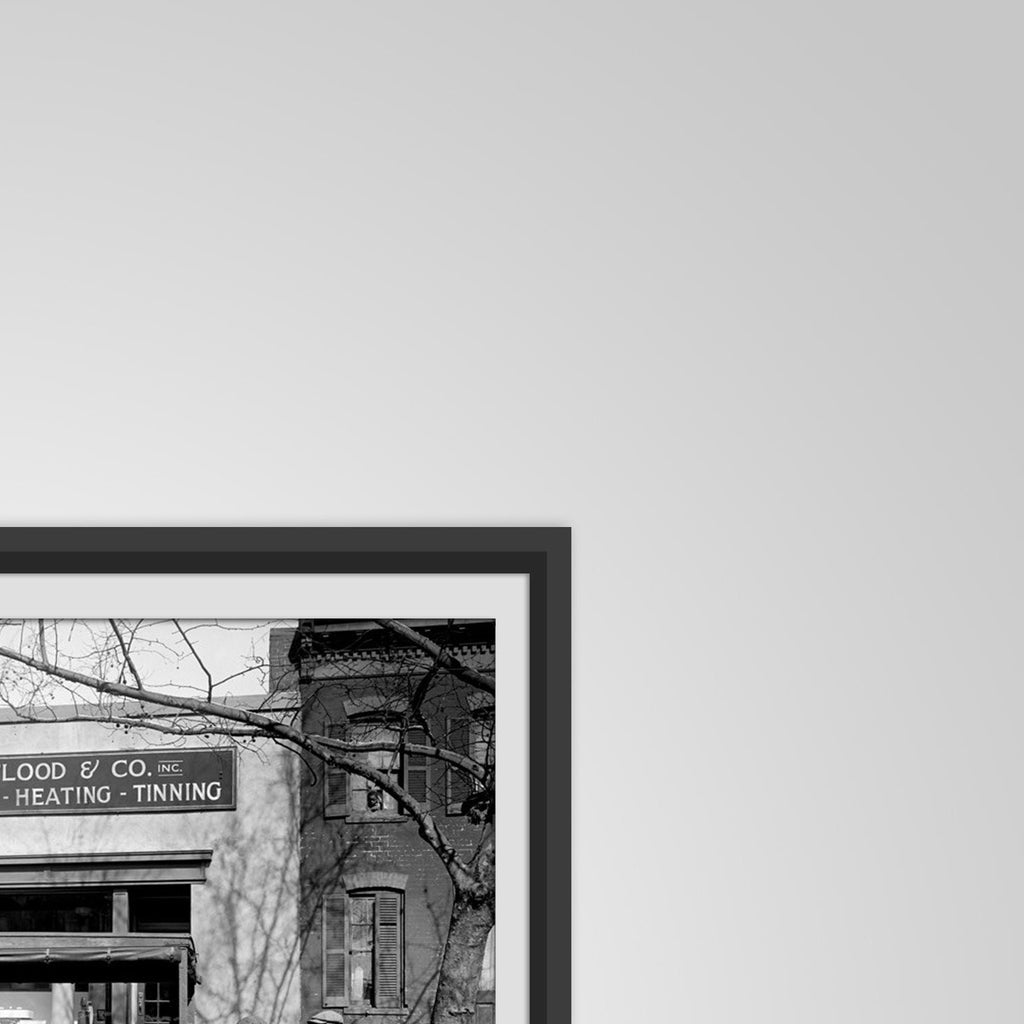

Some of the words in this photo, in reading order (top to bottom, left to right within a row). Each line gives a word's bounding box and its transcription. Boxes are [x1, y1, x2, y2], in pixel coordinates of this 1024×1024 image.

[80, 759, 100, 779] &
[111, 759, 153, 778] CO.
[158, 762, 183, 774] INC.
[16, 785, 112, 807] HEATING
[133, 781, 222, 803] TINNING
